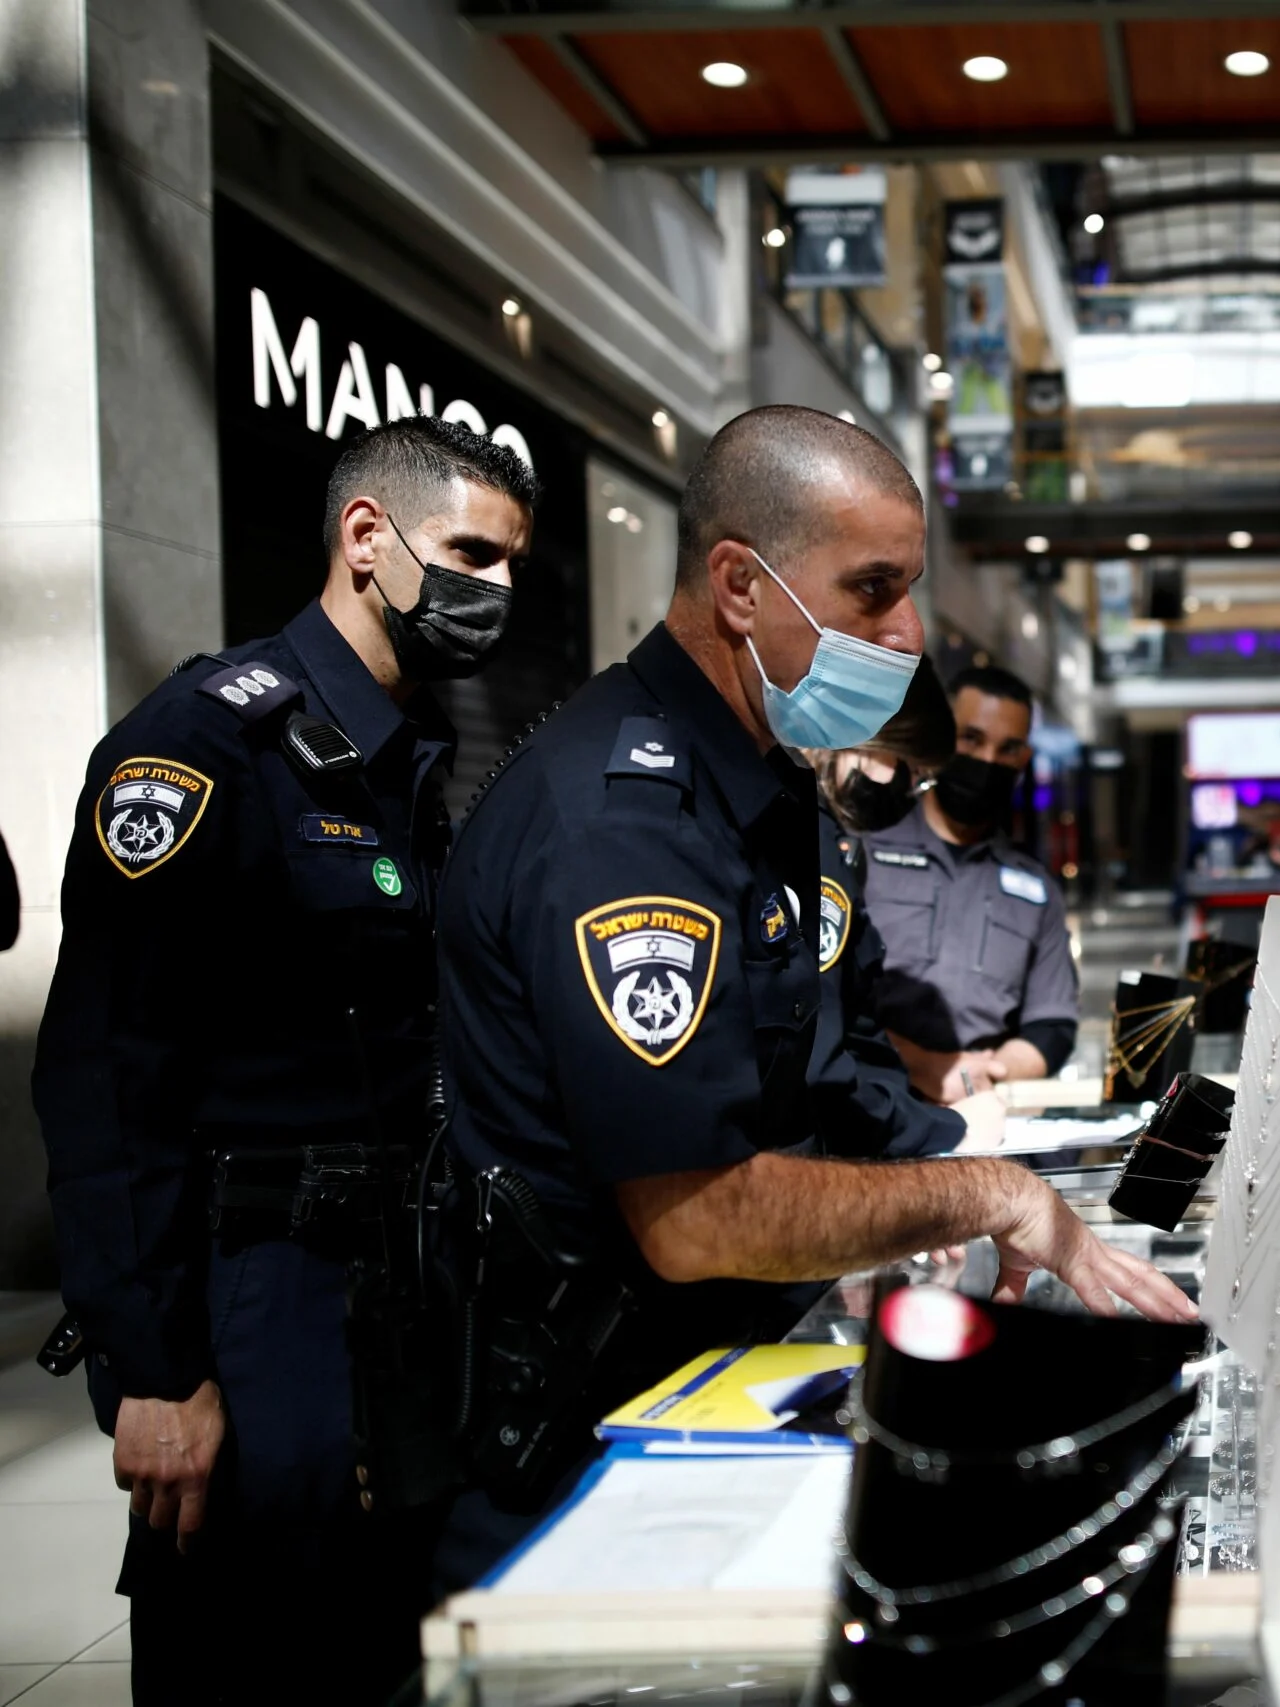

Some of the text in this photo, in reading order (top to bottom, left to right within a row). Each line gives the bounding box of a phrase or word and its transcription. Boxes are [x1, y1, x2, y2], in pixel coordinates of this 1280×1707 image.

[150, 766, 201, 793] משטרת
[589, 910, 709, 941] משטרת ישראל
